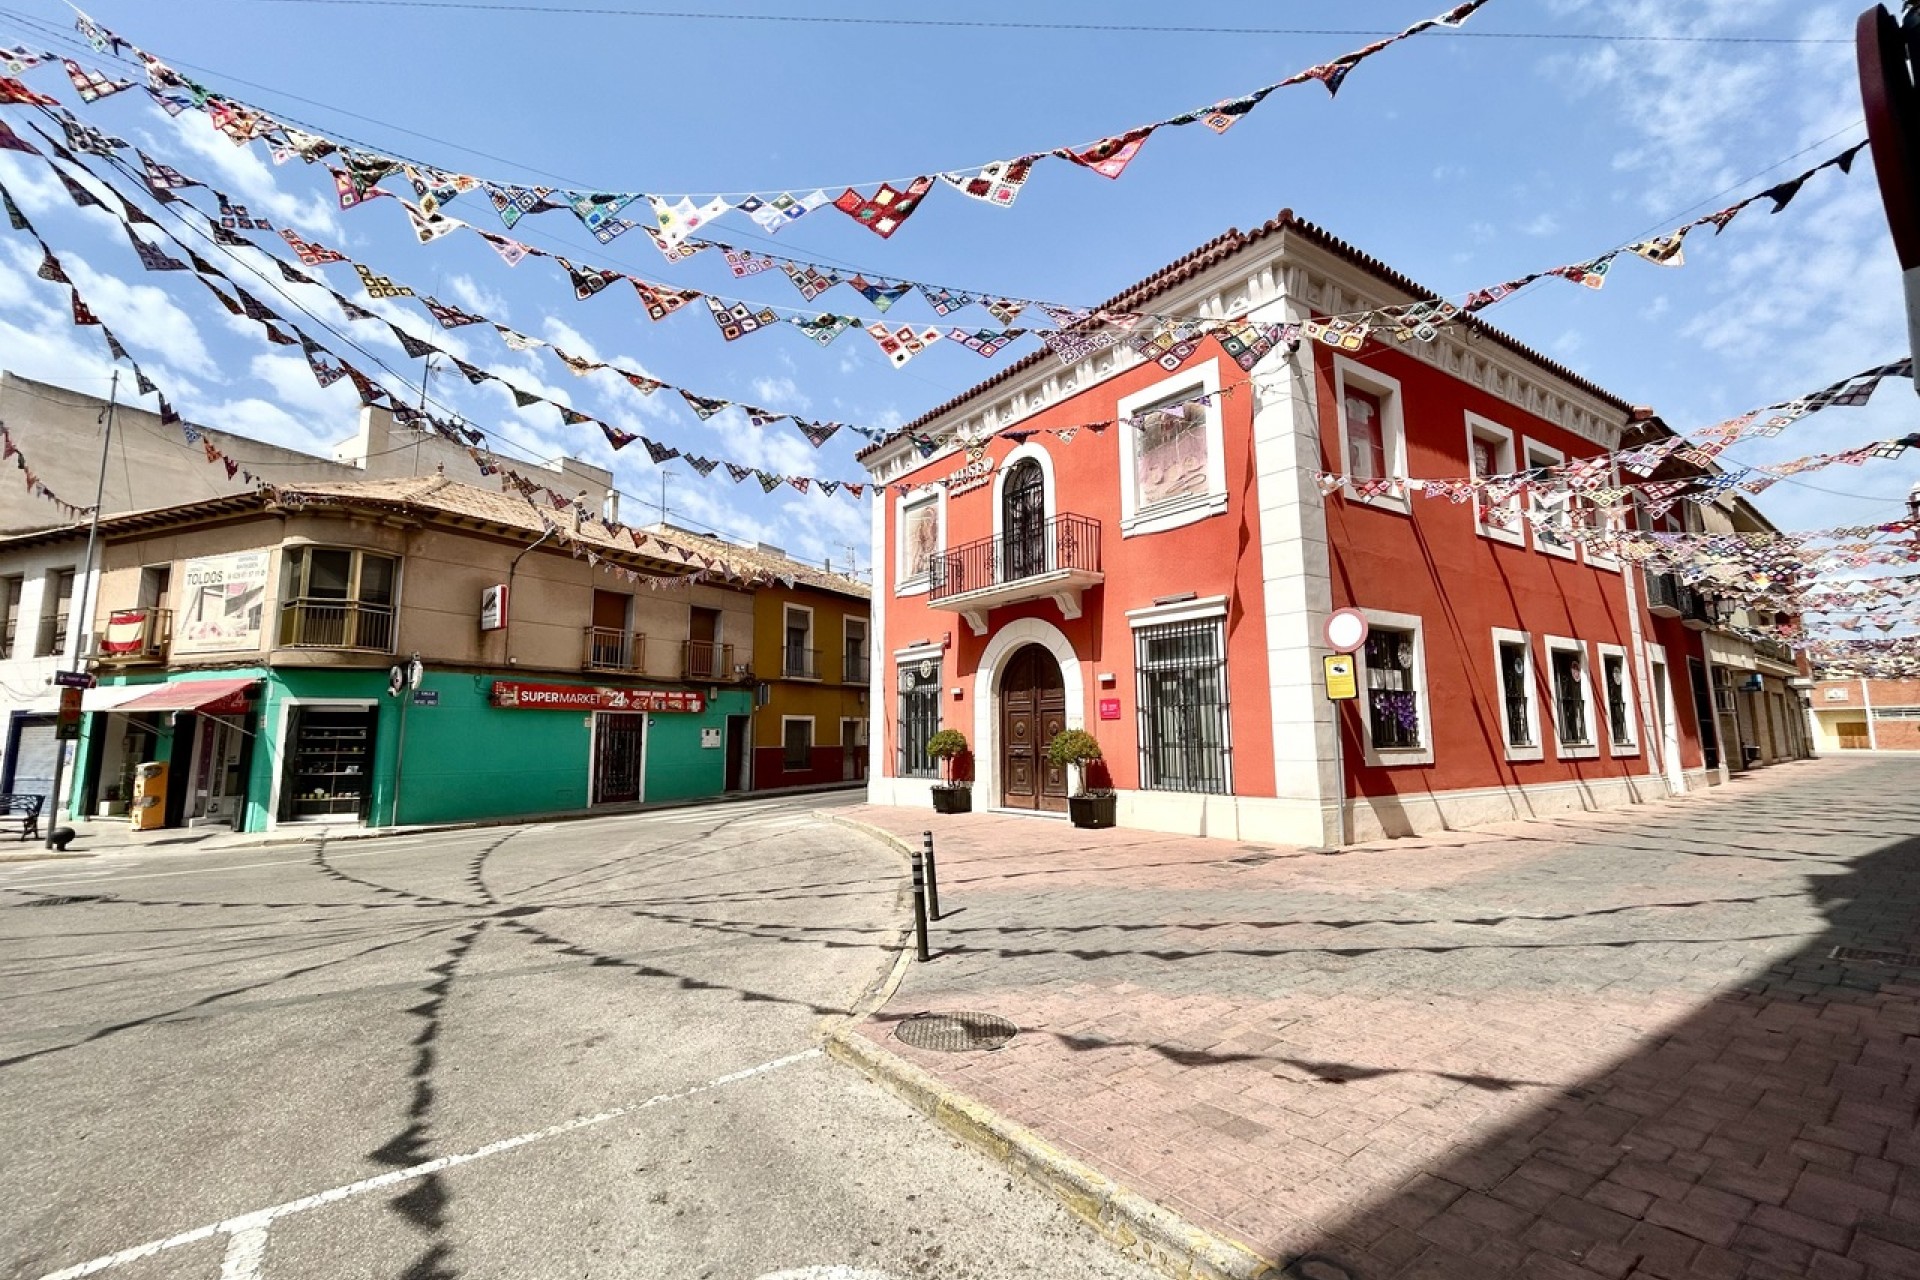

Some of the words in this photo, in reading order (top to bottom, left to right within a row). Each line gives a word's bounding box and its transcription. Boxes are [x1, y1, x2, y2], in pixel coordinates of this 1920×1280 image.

[950, 458, 993, 485] MUSEO
[187, 570, 223, 586] TOLDOS
[521, 690, 602, 705] SUPERMARKET
